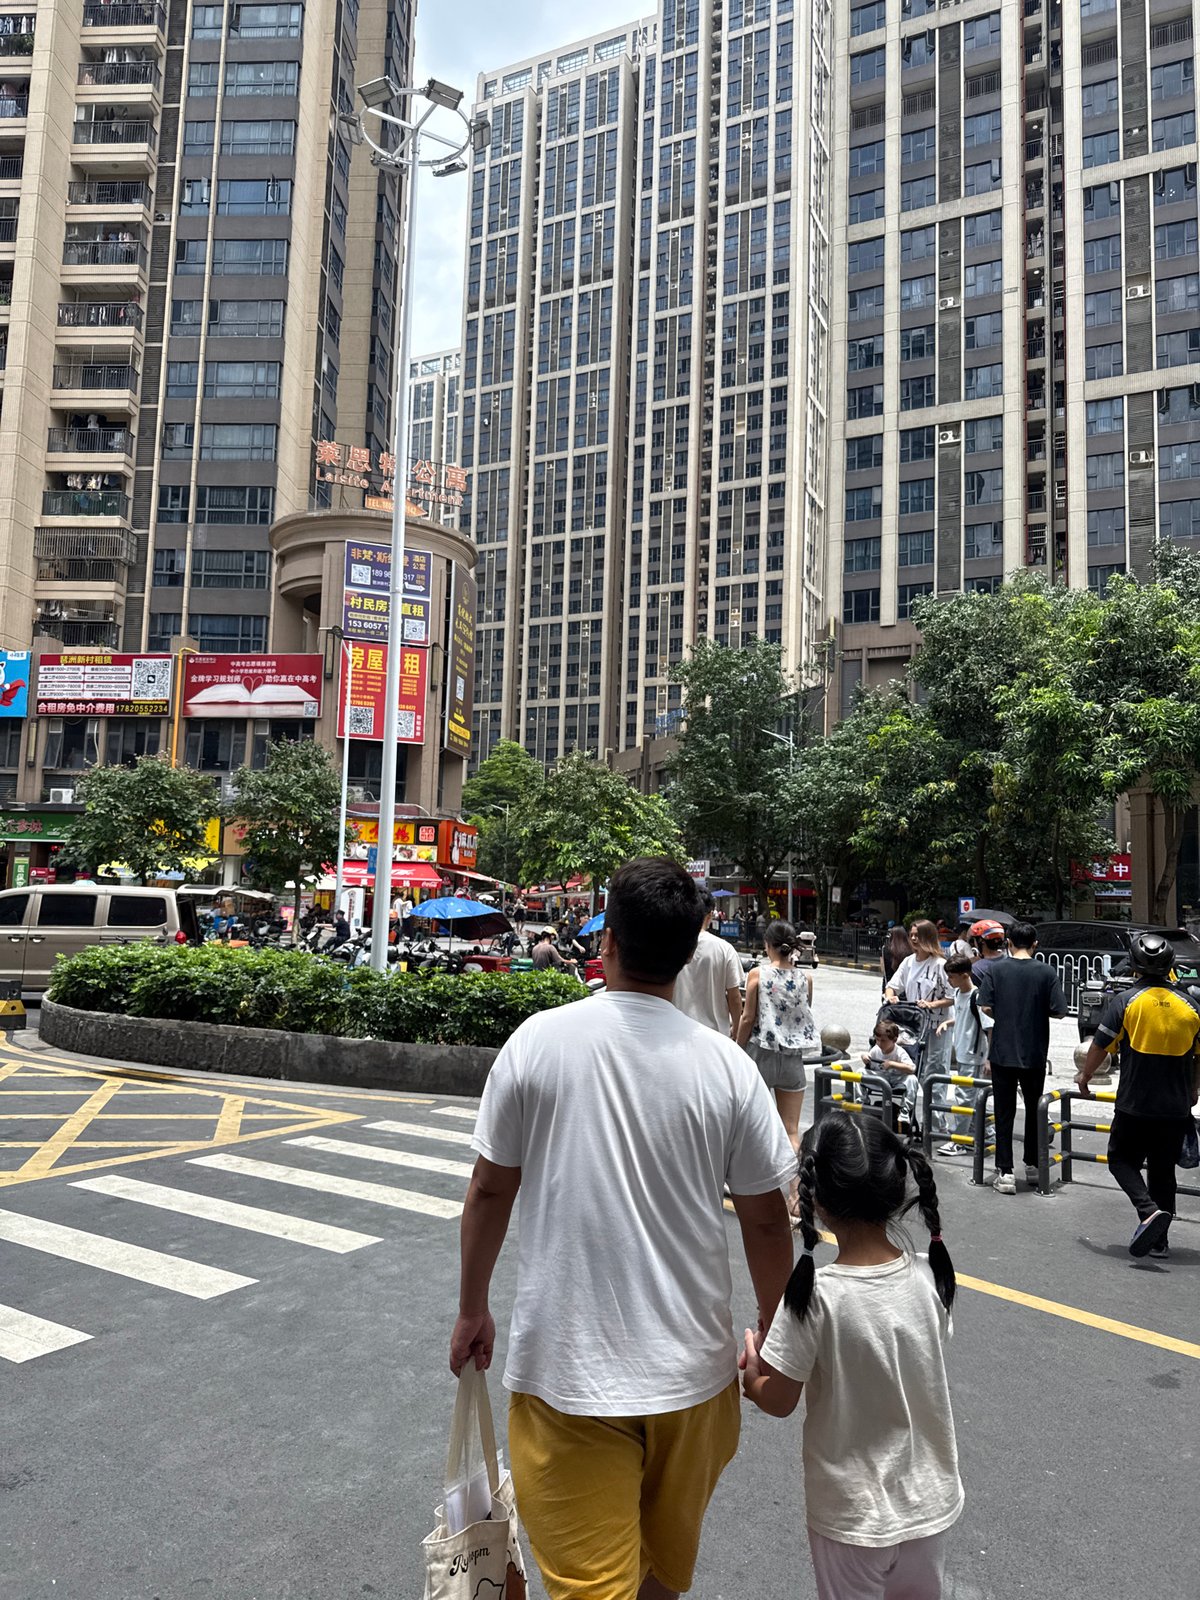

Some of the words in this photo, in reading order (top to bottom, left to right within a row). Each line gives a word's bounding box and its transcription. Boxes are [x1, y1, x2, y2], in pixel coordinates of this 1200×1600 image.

[316, 465, 369, 489] Laisite
[350, 596, 424, 617] 村民房直租
[351, 647, 420, 674] 房屋租
[190, 675, 241, 683] 金牌学习规划师
[265, 675, 317, 683] 助你赢在中高考
[38, 703, 115, 713] 合租房免中介费用
[116, 704, 168, 713] 17820552234
